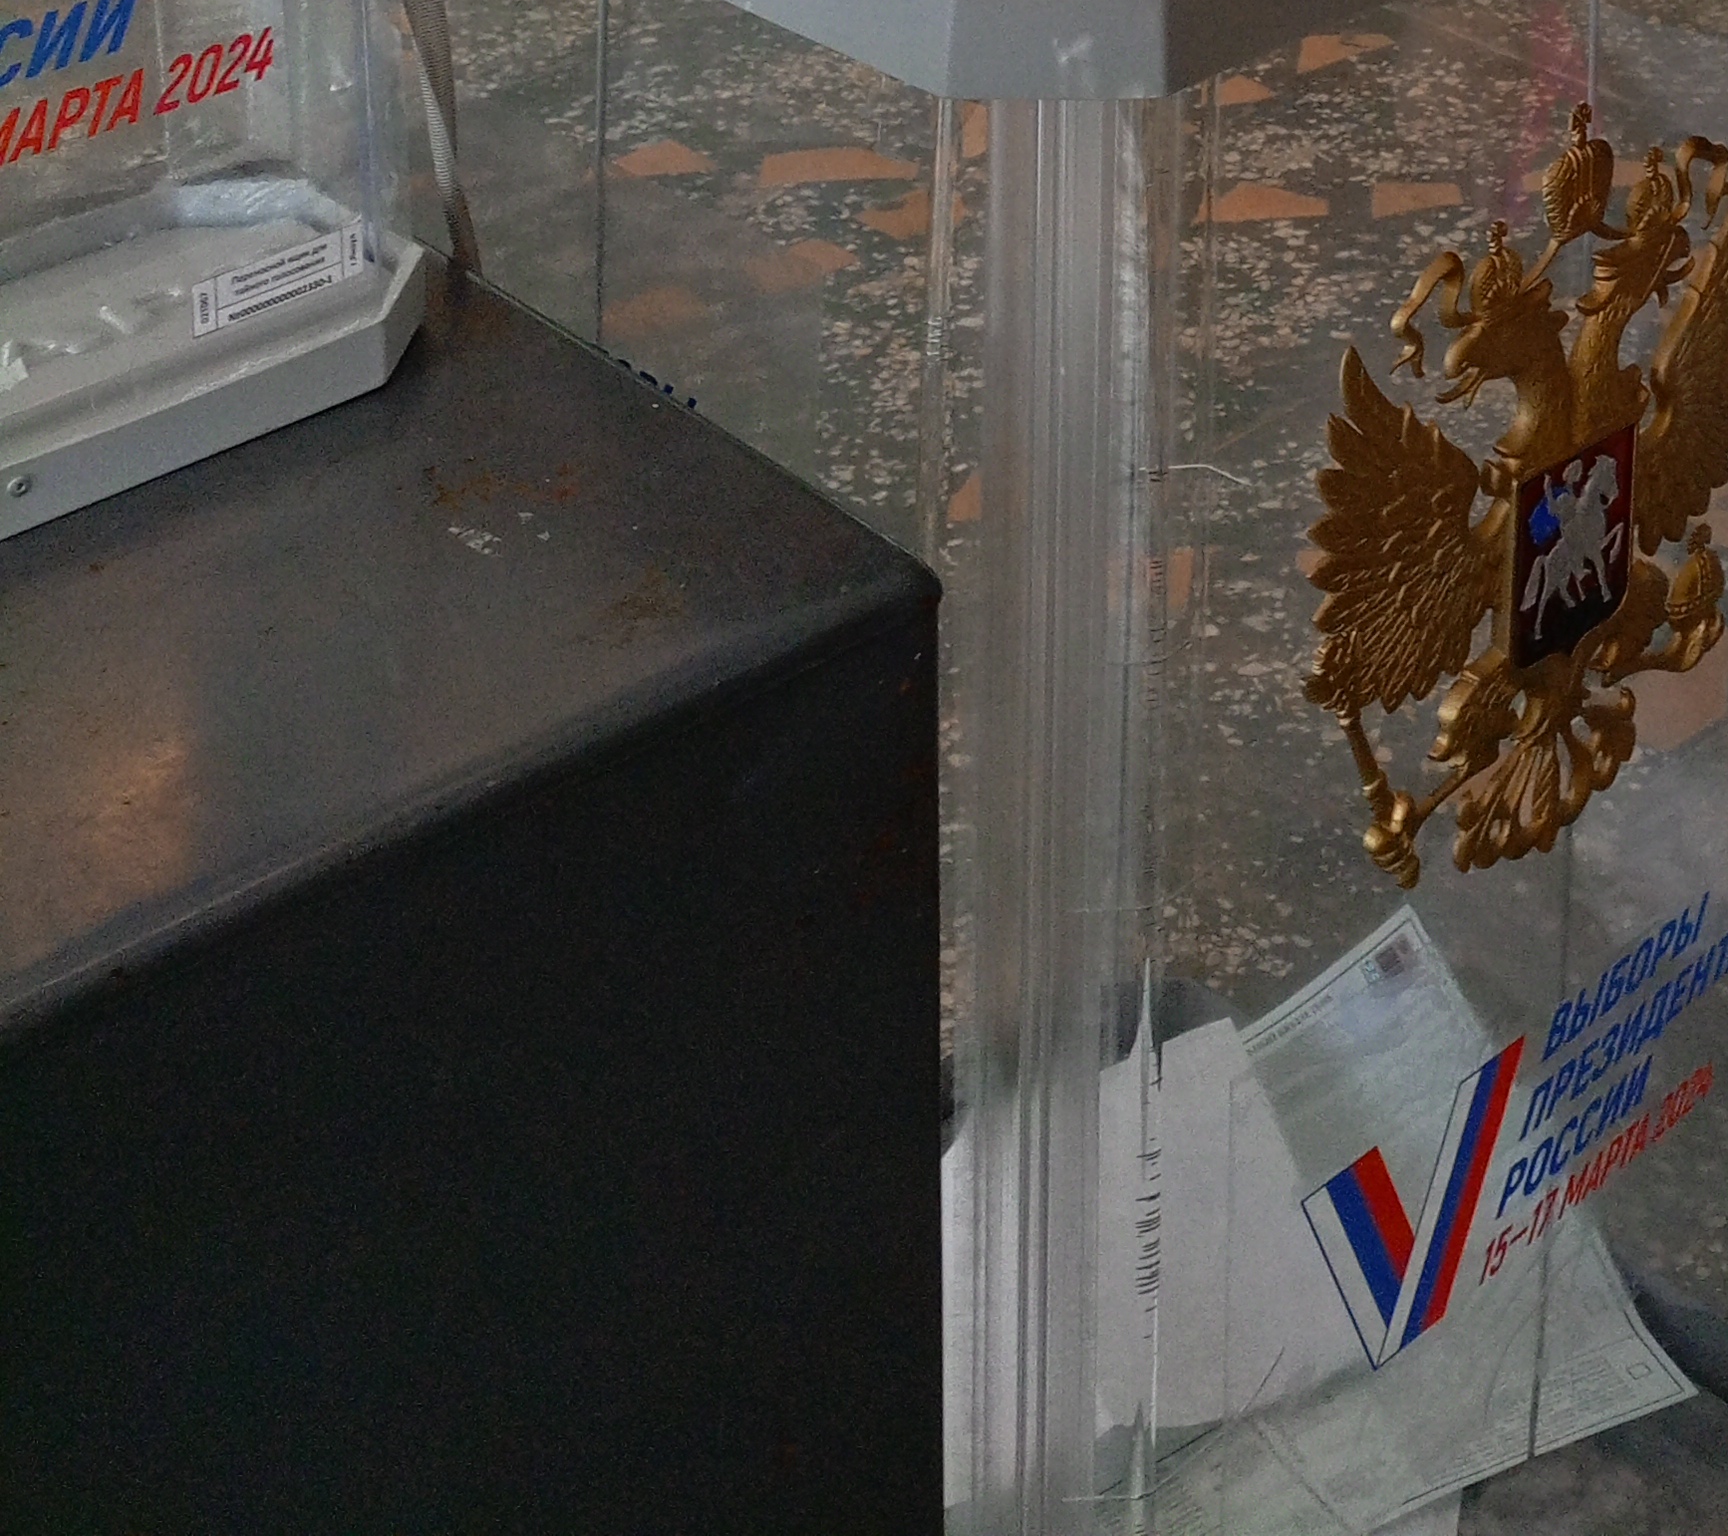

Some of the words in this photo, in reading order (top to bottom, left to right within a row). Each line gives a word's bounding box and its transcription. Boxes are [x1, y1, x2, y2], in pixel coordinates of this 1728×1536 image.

[153, 26, 275, 116] 2024
[1542, 891, 1710, 1062] ВЫБОРЫ
[1495, 1054, 1653, 1220] РОССИИ
[1558, 1113, 1651, 1220] МАРТА
[1650, 1062, 1715, 1144] 2024
